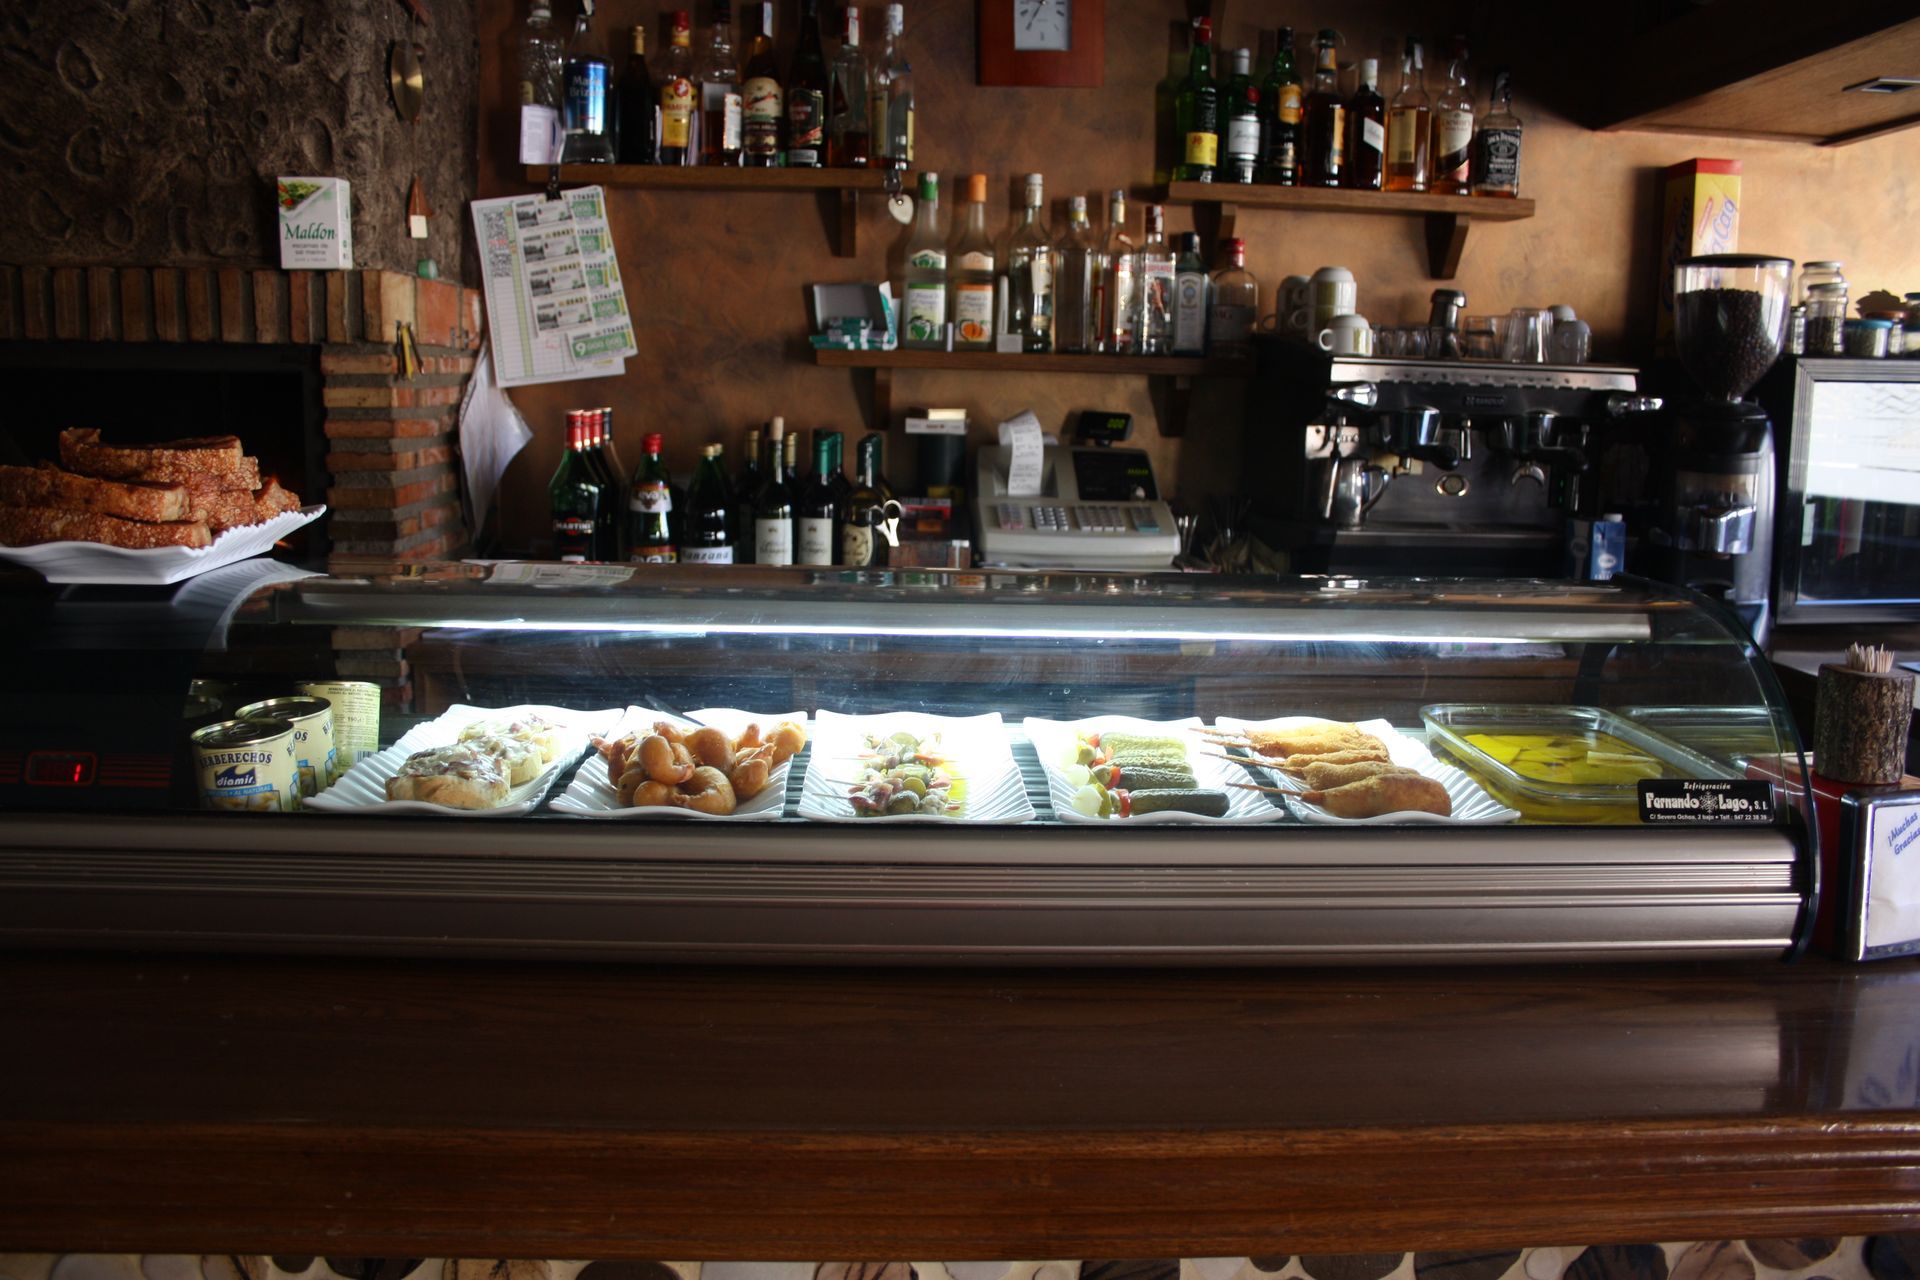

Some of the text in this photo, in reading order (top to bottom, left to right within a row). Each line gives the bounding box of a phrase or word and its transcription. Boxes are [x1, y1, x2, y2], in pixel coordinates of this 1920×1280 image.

[284, 222, 335, 240] Maldon
[1645, 792, 1700, 809] Fernando
[1718, 793, 1752, 811] Lago,
[1888, 812, 1918, 847] ¡Muchas
